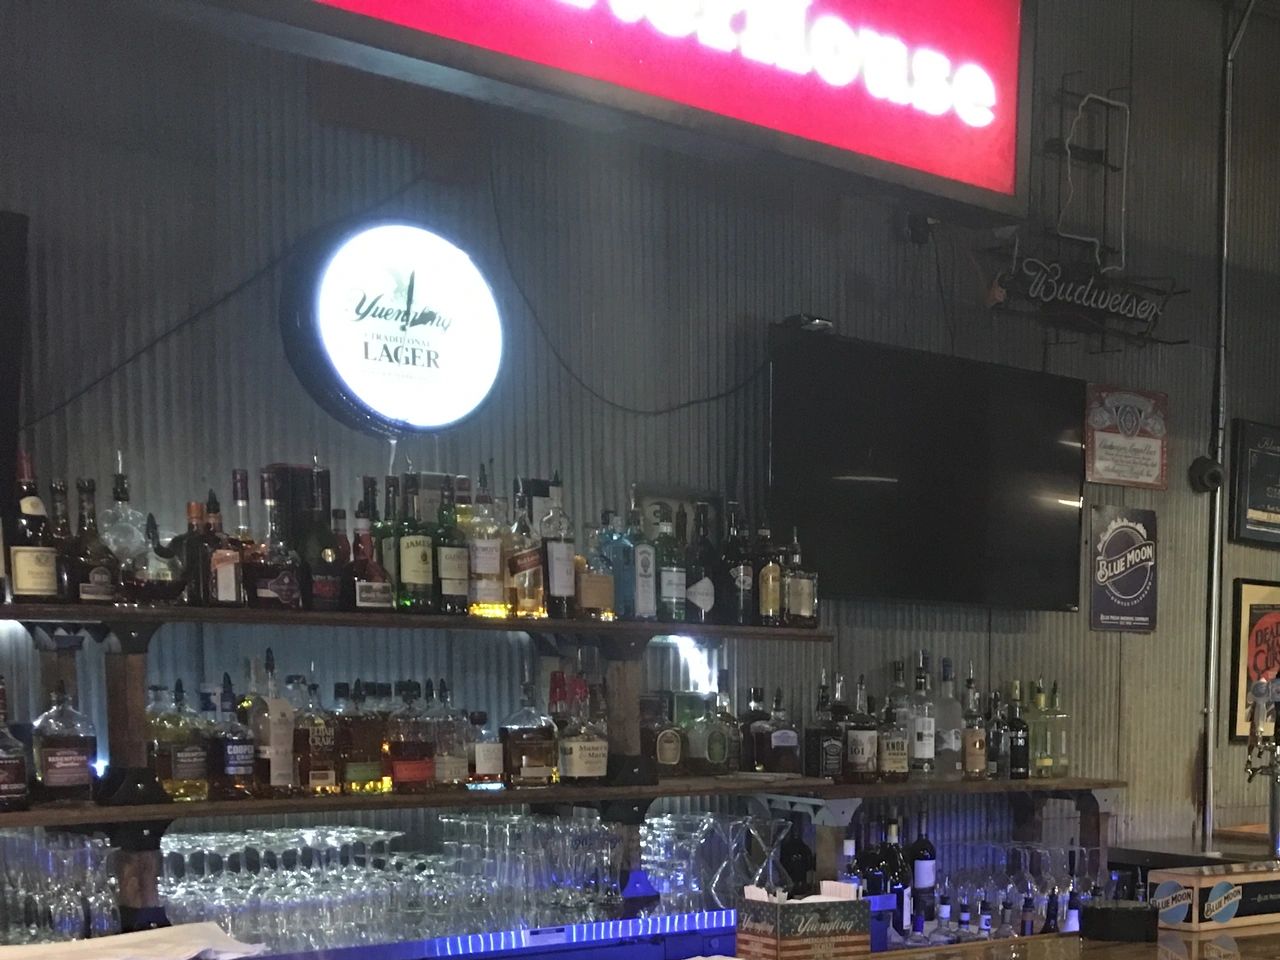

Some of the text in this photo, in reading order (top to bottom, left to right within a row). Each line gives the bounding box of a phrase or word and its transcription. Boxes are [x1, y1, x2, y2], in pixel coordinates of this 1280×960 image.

[1022, 258, 1162, 323] Budweiser
[362, 340, 440, 368] LAGER
[1097, 545, 1153, 582] BLUE MOON
[886, 741, 905, 751] KNOB
[1171, 889, 1192, 906] MOON
[1205, 889, 1241, 917] BLUE MOON
[791, 913, 857, 936] Yuengling
